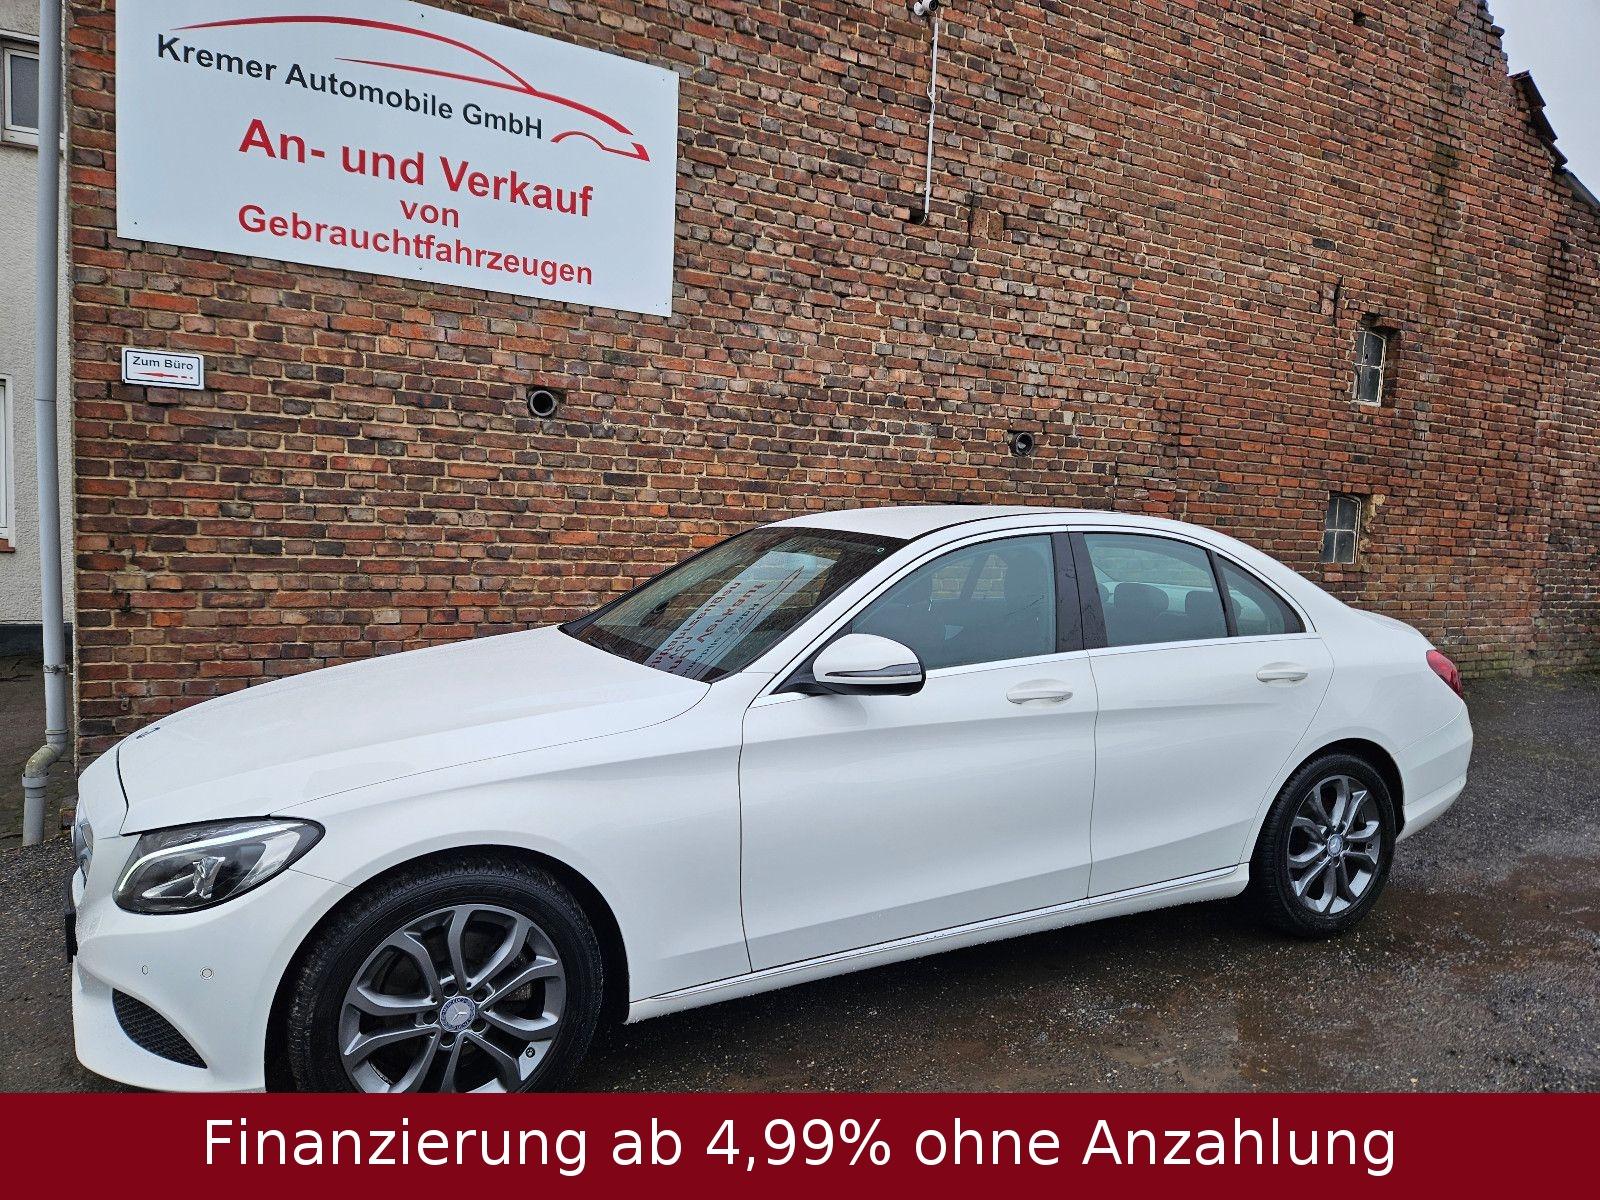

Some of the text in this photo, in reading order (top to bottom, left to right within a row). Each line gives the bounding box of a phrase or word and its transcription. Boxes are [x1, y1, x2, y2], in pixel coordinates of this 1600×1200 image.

[158, 33, 543, 140] Kremer Automobile GmbH
[239, 118, 594, 218] An- und Verkauf
[238, 204, 593, 286] Gebrauchtfahrzeugen
[399, 200, 460, 229] von
[132, 355, 194, 371] Zum Büro
